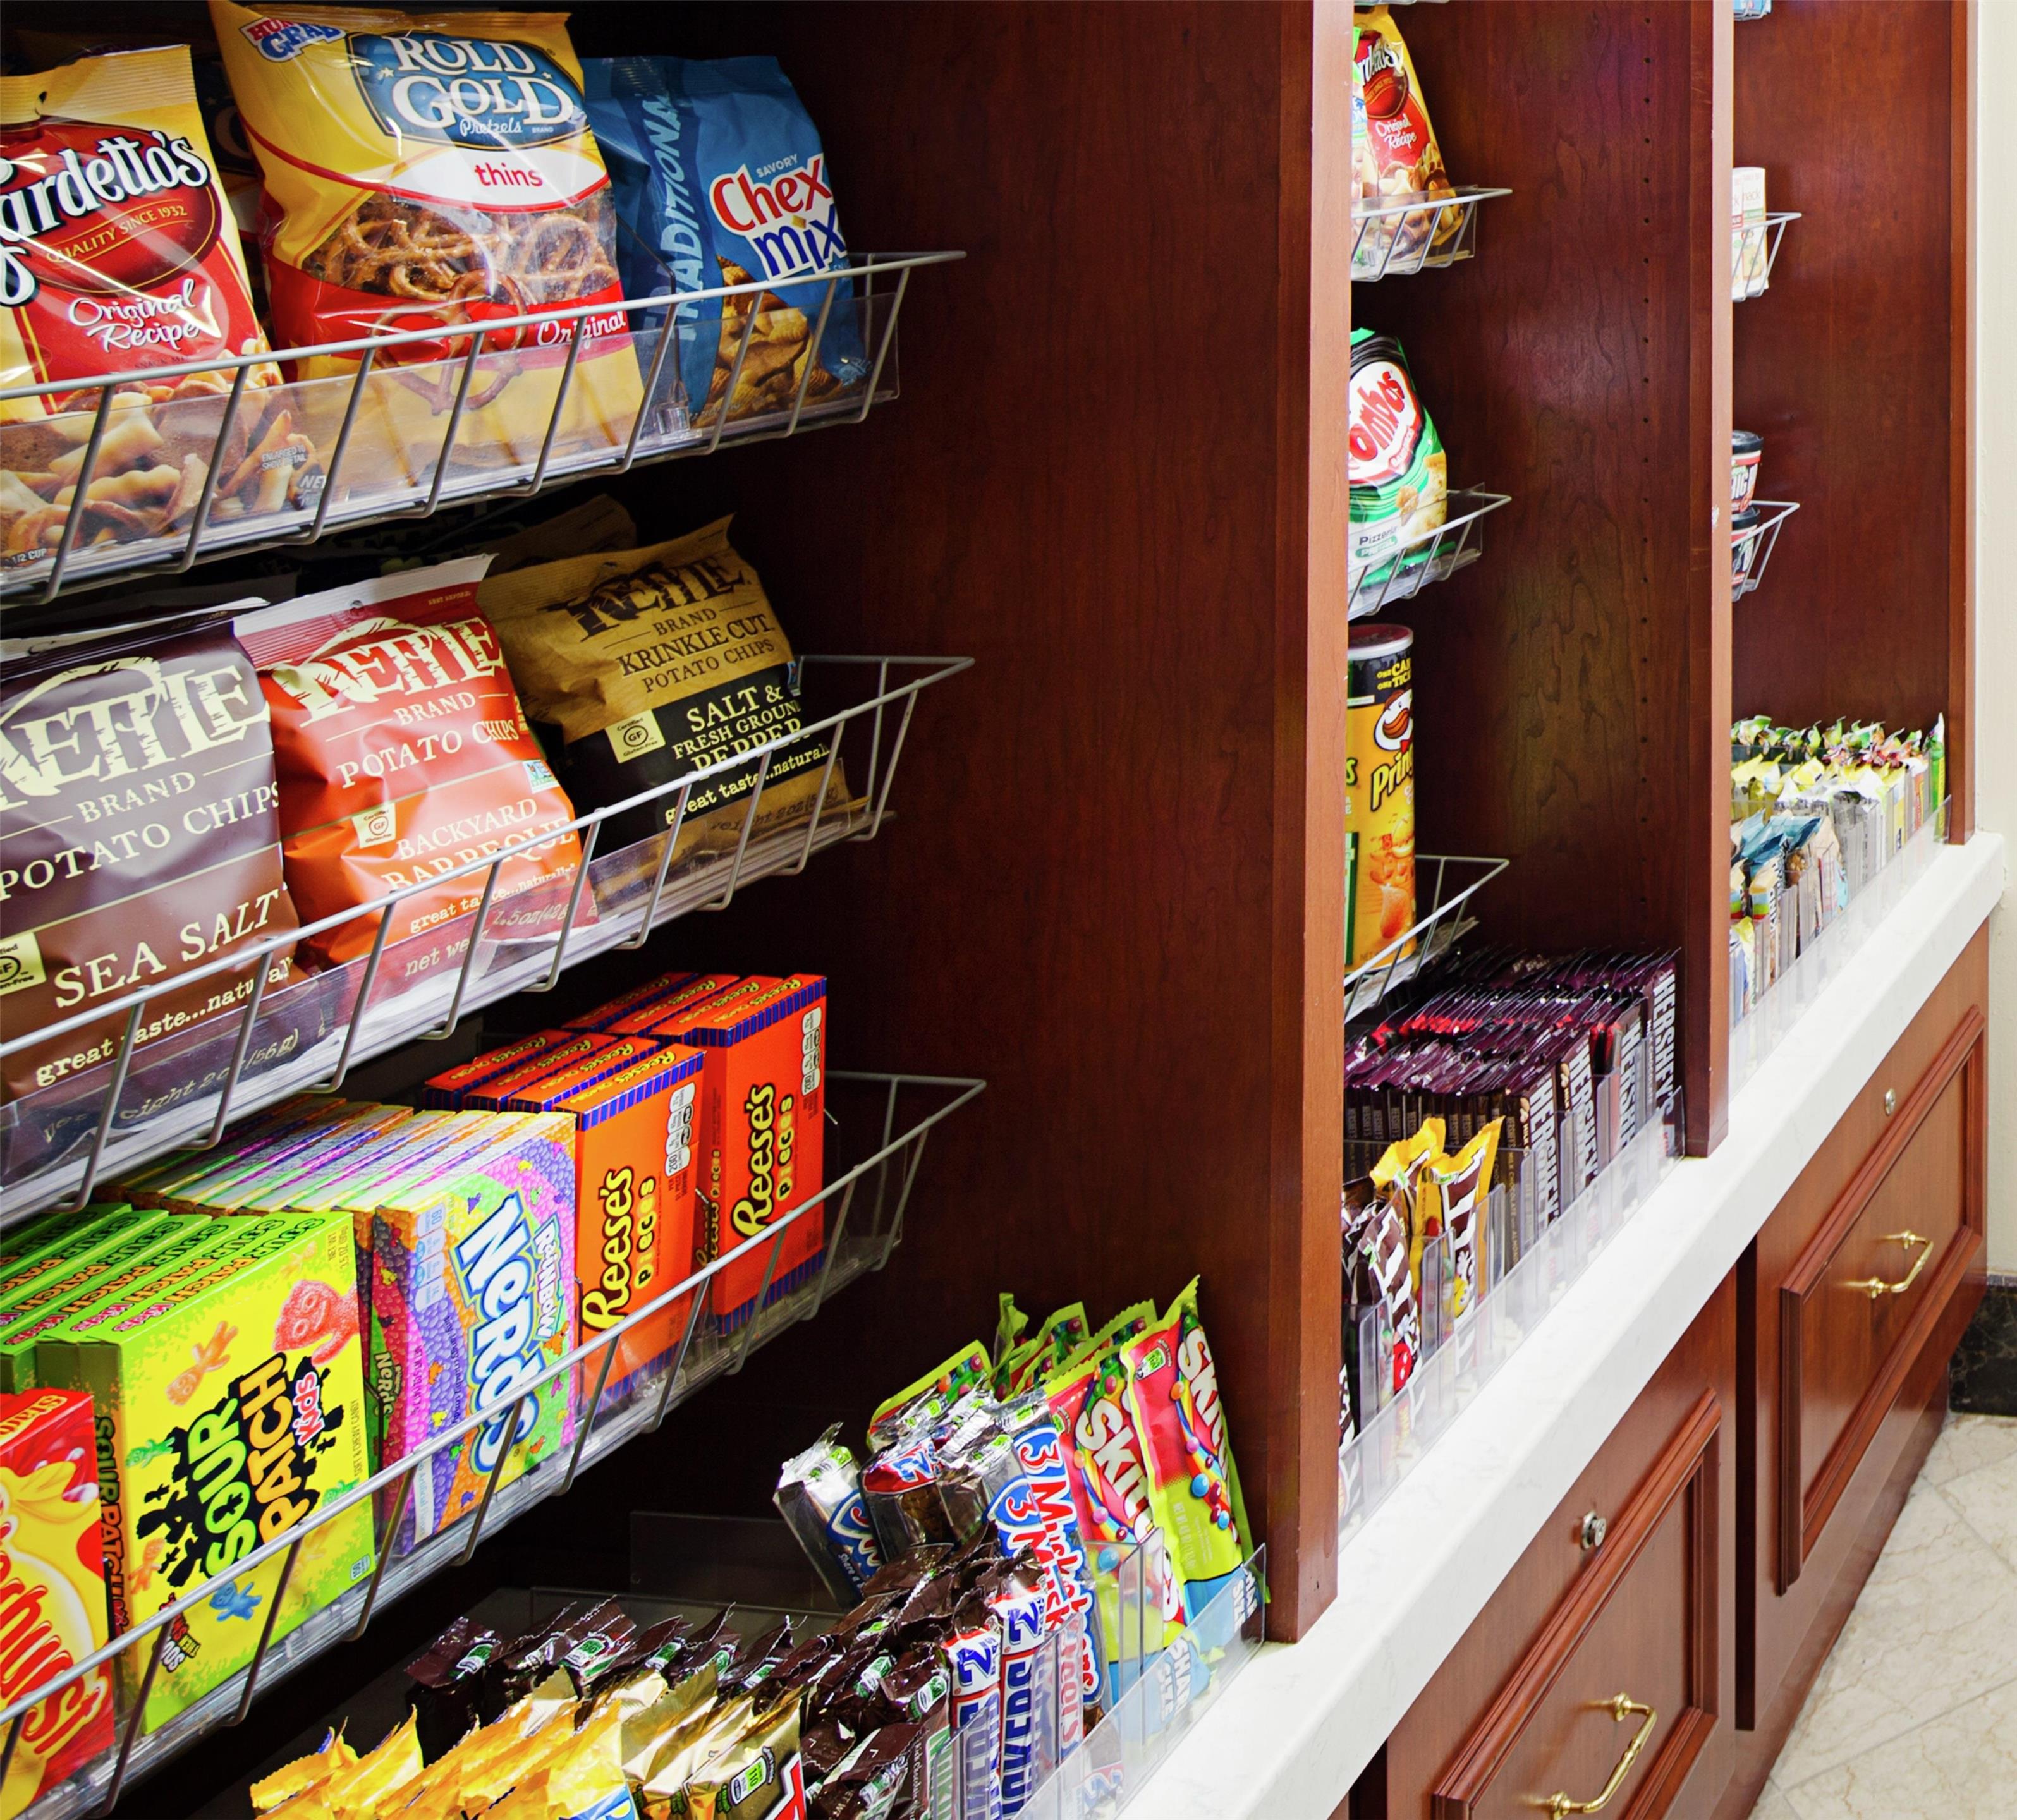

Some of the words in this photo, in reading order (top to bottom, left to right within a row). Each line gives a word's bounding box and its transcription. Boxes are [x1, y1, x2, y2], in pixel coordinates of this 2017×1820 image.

[381, 35, 536, 76] ROLD
[392, 75, 573, 129] GOLD
[460, 117, 524, 137] Pretzels
[532, 126, 554, 134] BRAND
[475, 162, 544, 188] thins
[756, 154, 798, 178] SAVORY
[0, 131, 212, 306] ardetto's
[713, 158, 832, 232] Chex
[119, 209, 158, 239] SINCE
[159, 203, 188, 222] 1932
[753, 204, 846, 278] mix
[69, 278, 195, 327] Original
[87, 322, 201, 353] Recipe
[537, 310, 627, 350] Orginal
[1348, 370, 1406, 462] ombos
[27, 547, 47, 561] CUP
[616, 625, 729, 678] KRINKLE
[726, 613, 775, 641] CUT
[653, 607, 717, 637] BRAND
[642, 655, 721, 693] POTATO
[722, 638, 776, 664] CHIPS
[393, 691, 476, 727] BRAND
[686, 686, 760, 734] SALT
[764, 684, 784, 704] &
[336, 730, 463, 789] POTATO
[472, 718, 520, 744] CHIPS
[628, 731, 643, 742] GF
[671, 726, 735, 760] FRESH
[77, 771, 196, 823] BRAND
[0, 823, 171, 899] POTATO
[183, 781, 279, 835] CHIPS
[397, 798, 537, 861] BACKYARD
[410, 904, 456, 933] great
[54, 941, 167, 1009] SEA
[179, 888, 279, 962] SALT
[36, 1037, 114, 1087] great
[733, 1084, 776, 1237] Reese's
[582, 1168, 633, 1329] Reese's
[95, 1416, 120, 1503] SOUR
[238, 1355, 310, 1544] PATCH
[1020, 1440, 1062, 1470] 3
[188, 1397, 258, 1577] SOUR
[1005, 1498, 1039, 1522] 3
